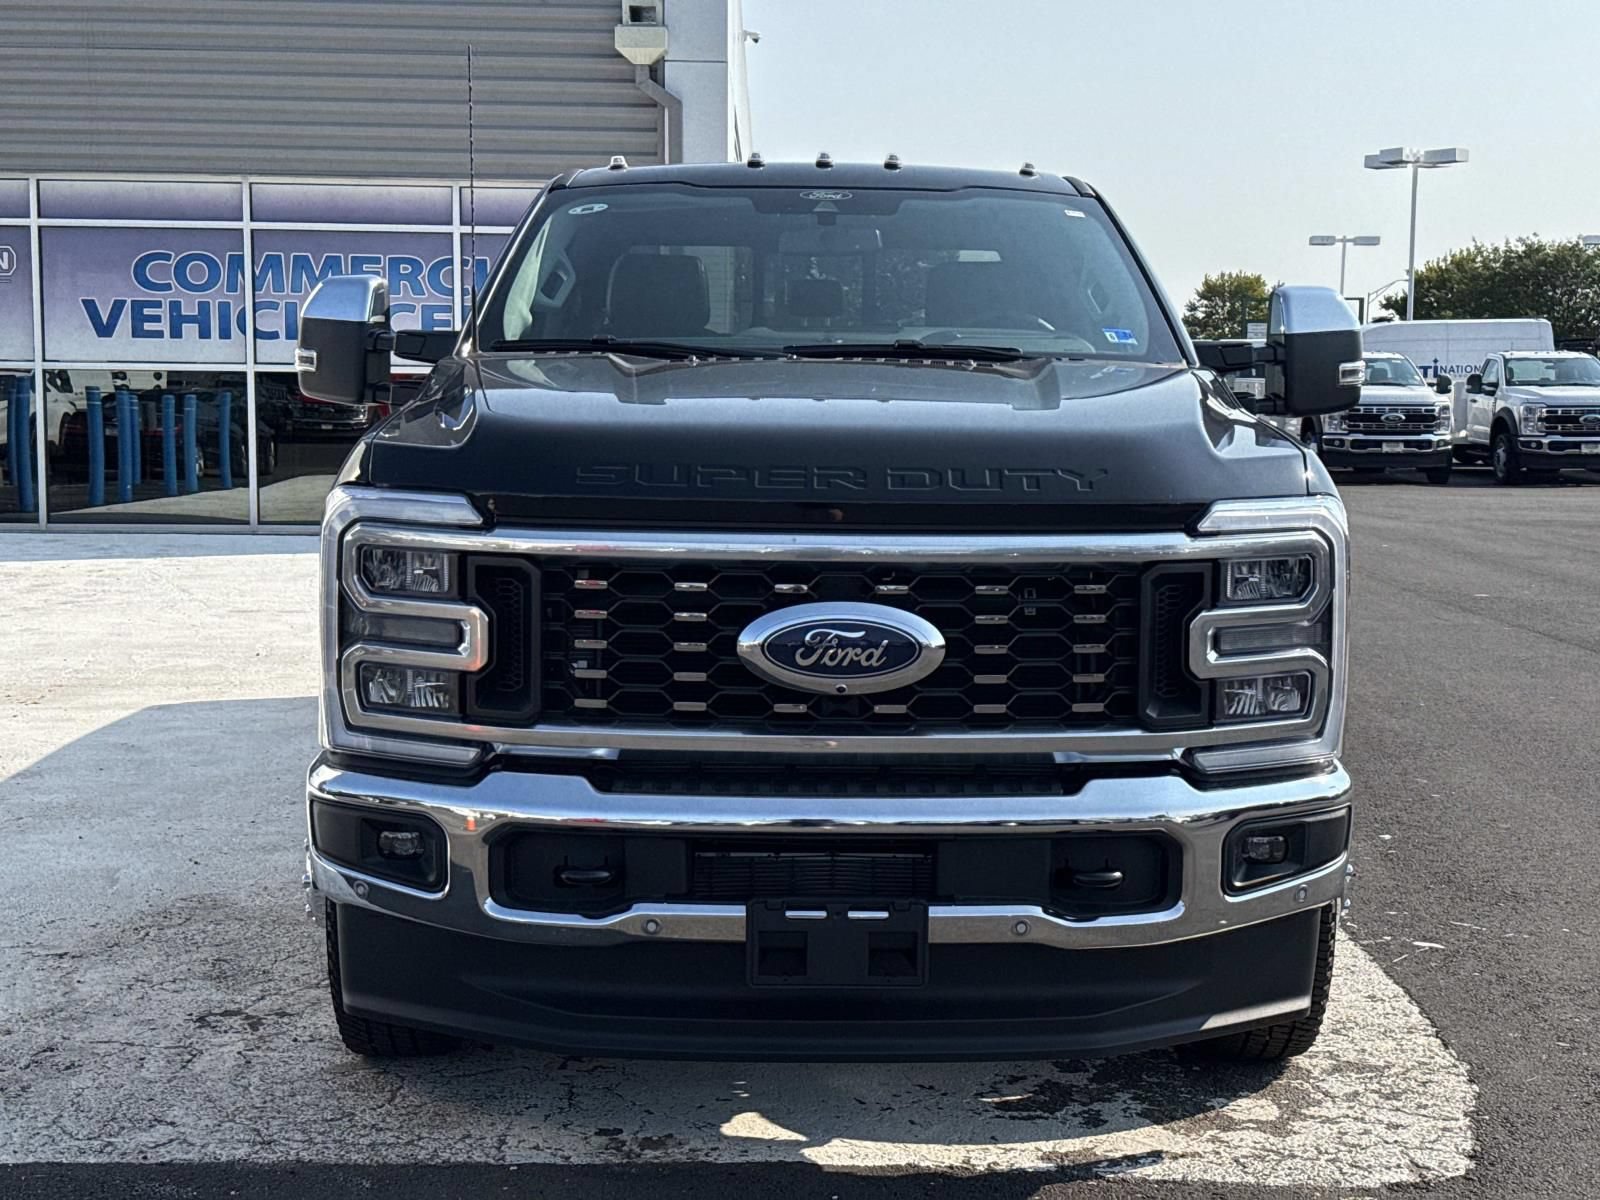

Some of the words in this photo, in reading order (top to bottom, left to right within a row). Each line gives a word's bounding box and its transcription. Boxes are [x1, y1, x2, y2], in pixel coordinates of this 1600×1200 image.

[575, 463, 866, 490] SUPER
[887, 467, 1108, 492] DUTY
[795, 628, 889, 667] Ford
